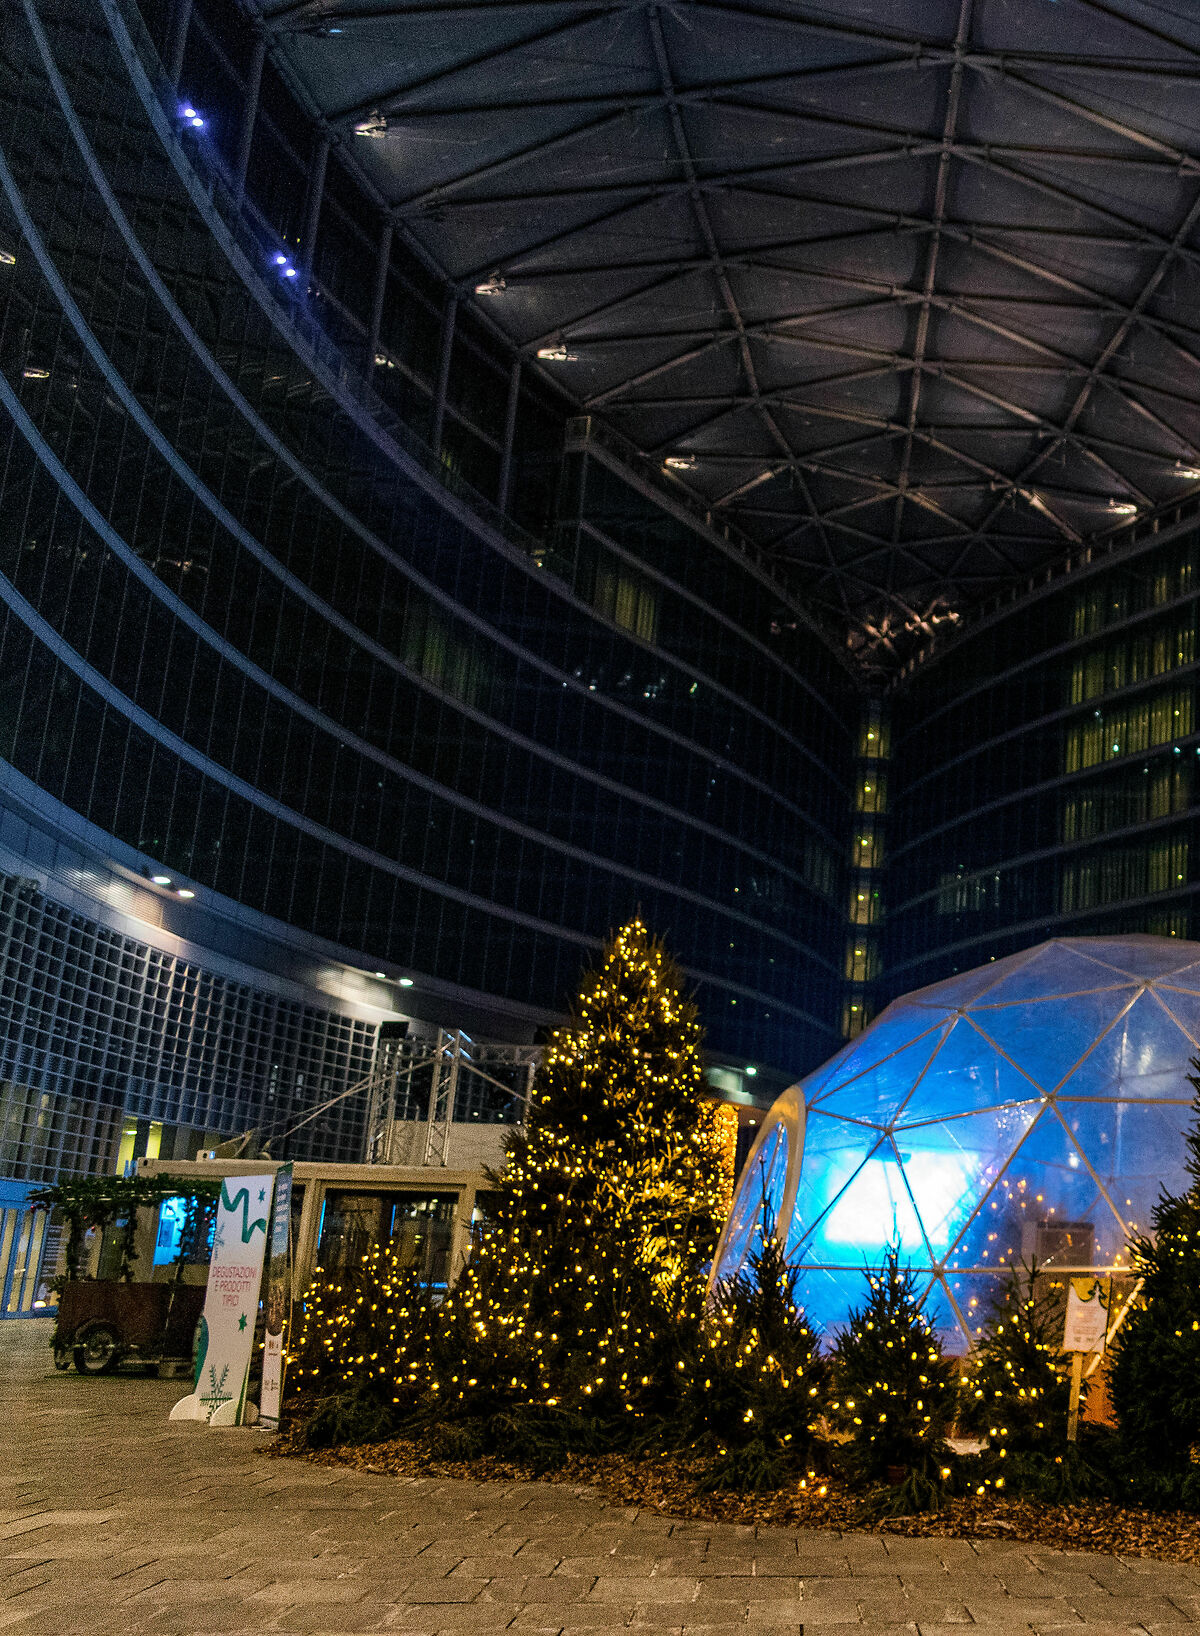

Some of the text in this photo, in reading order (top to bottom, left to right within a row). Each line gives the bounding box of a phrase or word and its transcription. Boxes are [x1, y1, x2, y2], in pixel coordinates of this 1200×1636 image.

[211, 1265, 257, 1278] DEGUSTAZIONI
[220, 1280, 251, 1292] PRODOTTI
[222, 1294, 239, 1307] TIPICI
